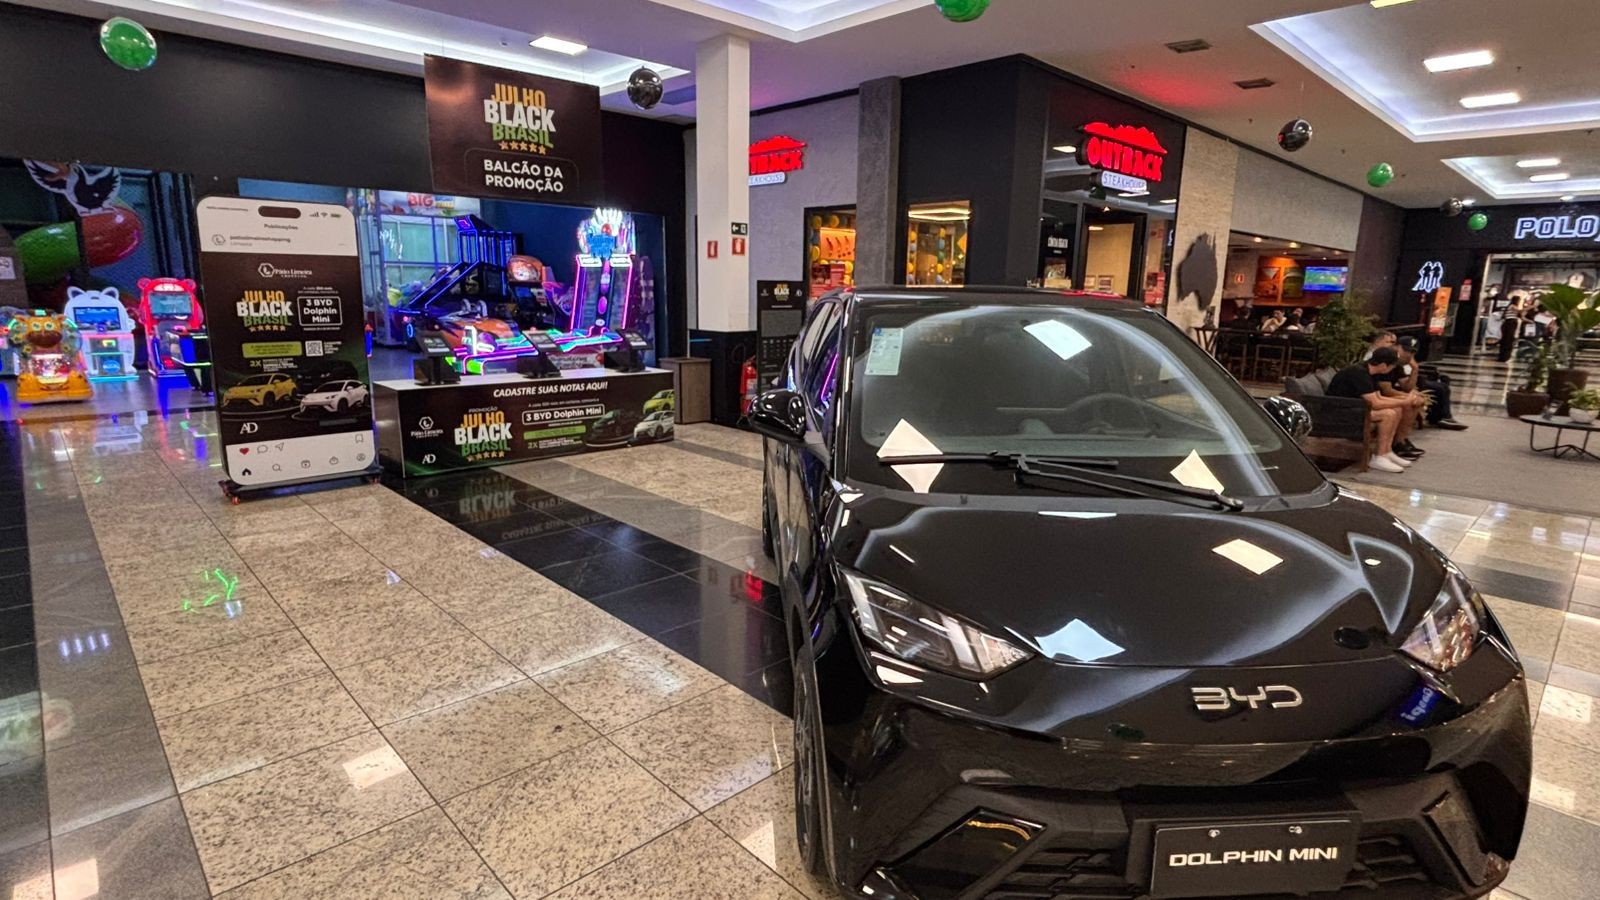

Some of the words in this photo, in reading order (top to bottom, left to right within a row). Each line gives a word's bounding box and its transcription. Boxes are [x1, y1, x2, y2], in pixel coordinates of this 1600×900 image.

[491, 83, 546, 108] JULHO
[484, 100, 556, 132] BLACK
[492, 123, 555, 148] BRASIL
[484, 159, 540, 176] BALCÃO
[544, 166, 563, 178] DA
[749, 150, 802, 174] TBACK
[1087, 136, 1163, 182] OUTBACK
[485, 174, 564, 193] PROMOÇÃO
[1514, 215, 1599, 239] POLO
[241, 290, 285, 303] JULHO
[314, 298, 332, 306] BYD
[236, 301, 294, 317] BLACK
[304, 307, 338, 316] Dolphin
[243, 314, 293, 327] BRASIL
[493, 386, 536, 398] CADASTRE
[538, 384, 558, 394] SUAS
[560, 382, 585, 392] NOTAS
[460, 410, 504, 428] JULHO
[526, 413, 532, 421] 3
[534, 412, 552, 420] BYD
[554, 408, 584, 418] Dolphin
[586, 406, 602, 416] Mini
[454, 422, 512, 446] BLACK
[461, 440, 512, 457] BRASIL
[1191, 684, 1303, 711] BYD
[1168, 848, 1283, 868] DOLPHIN
[1289, 846, 1338, 862] MINI
